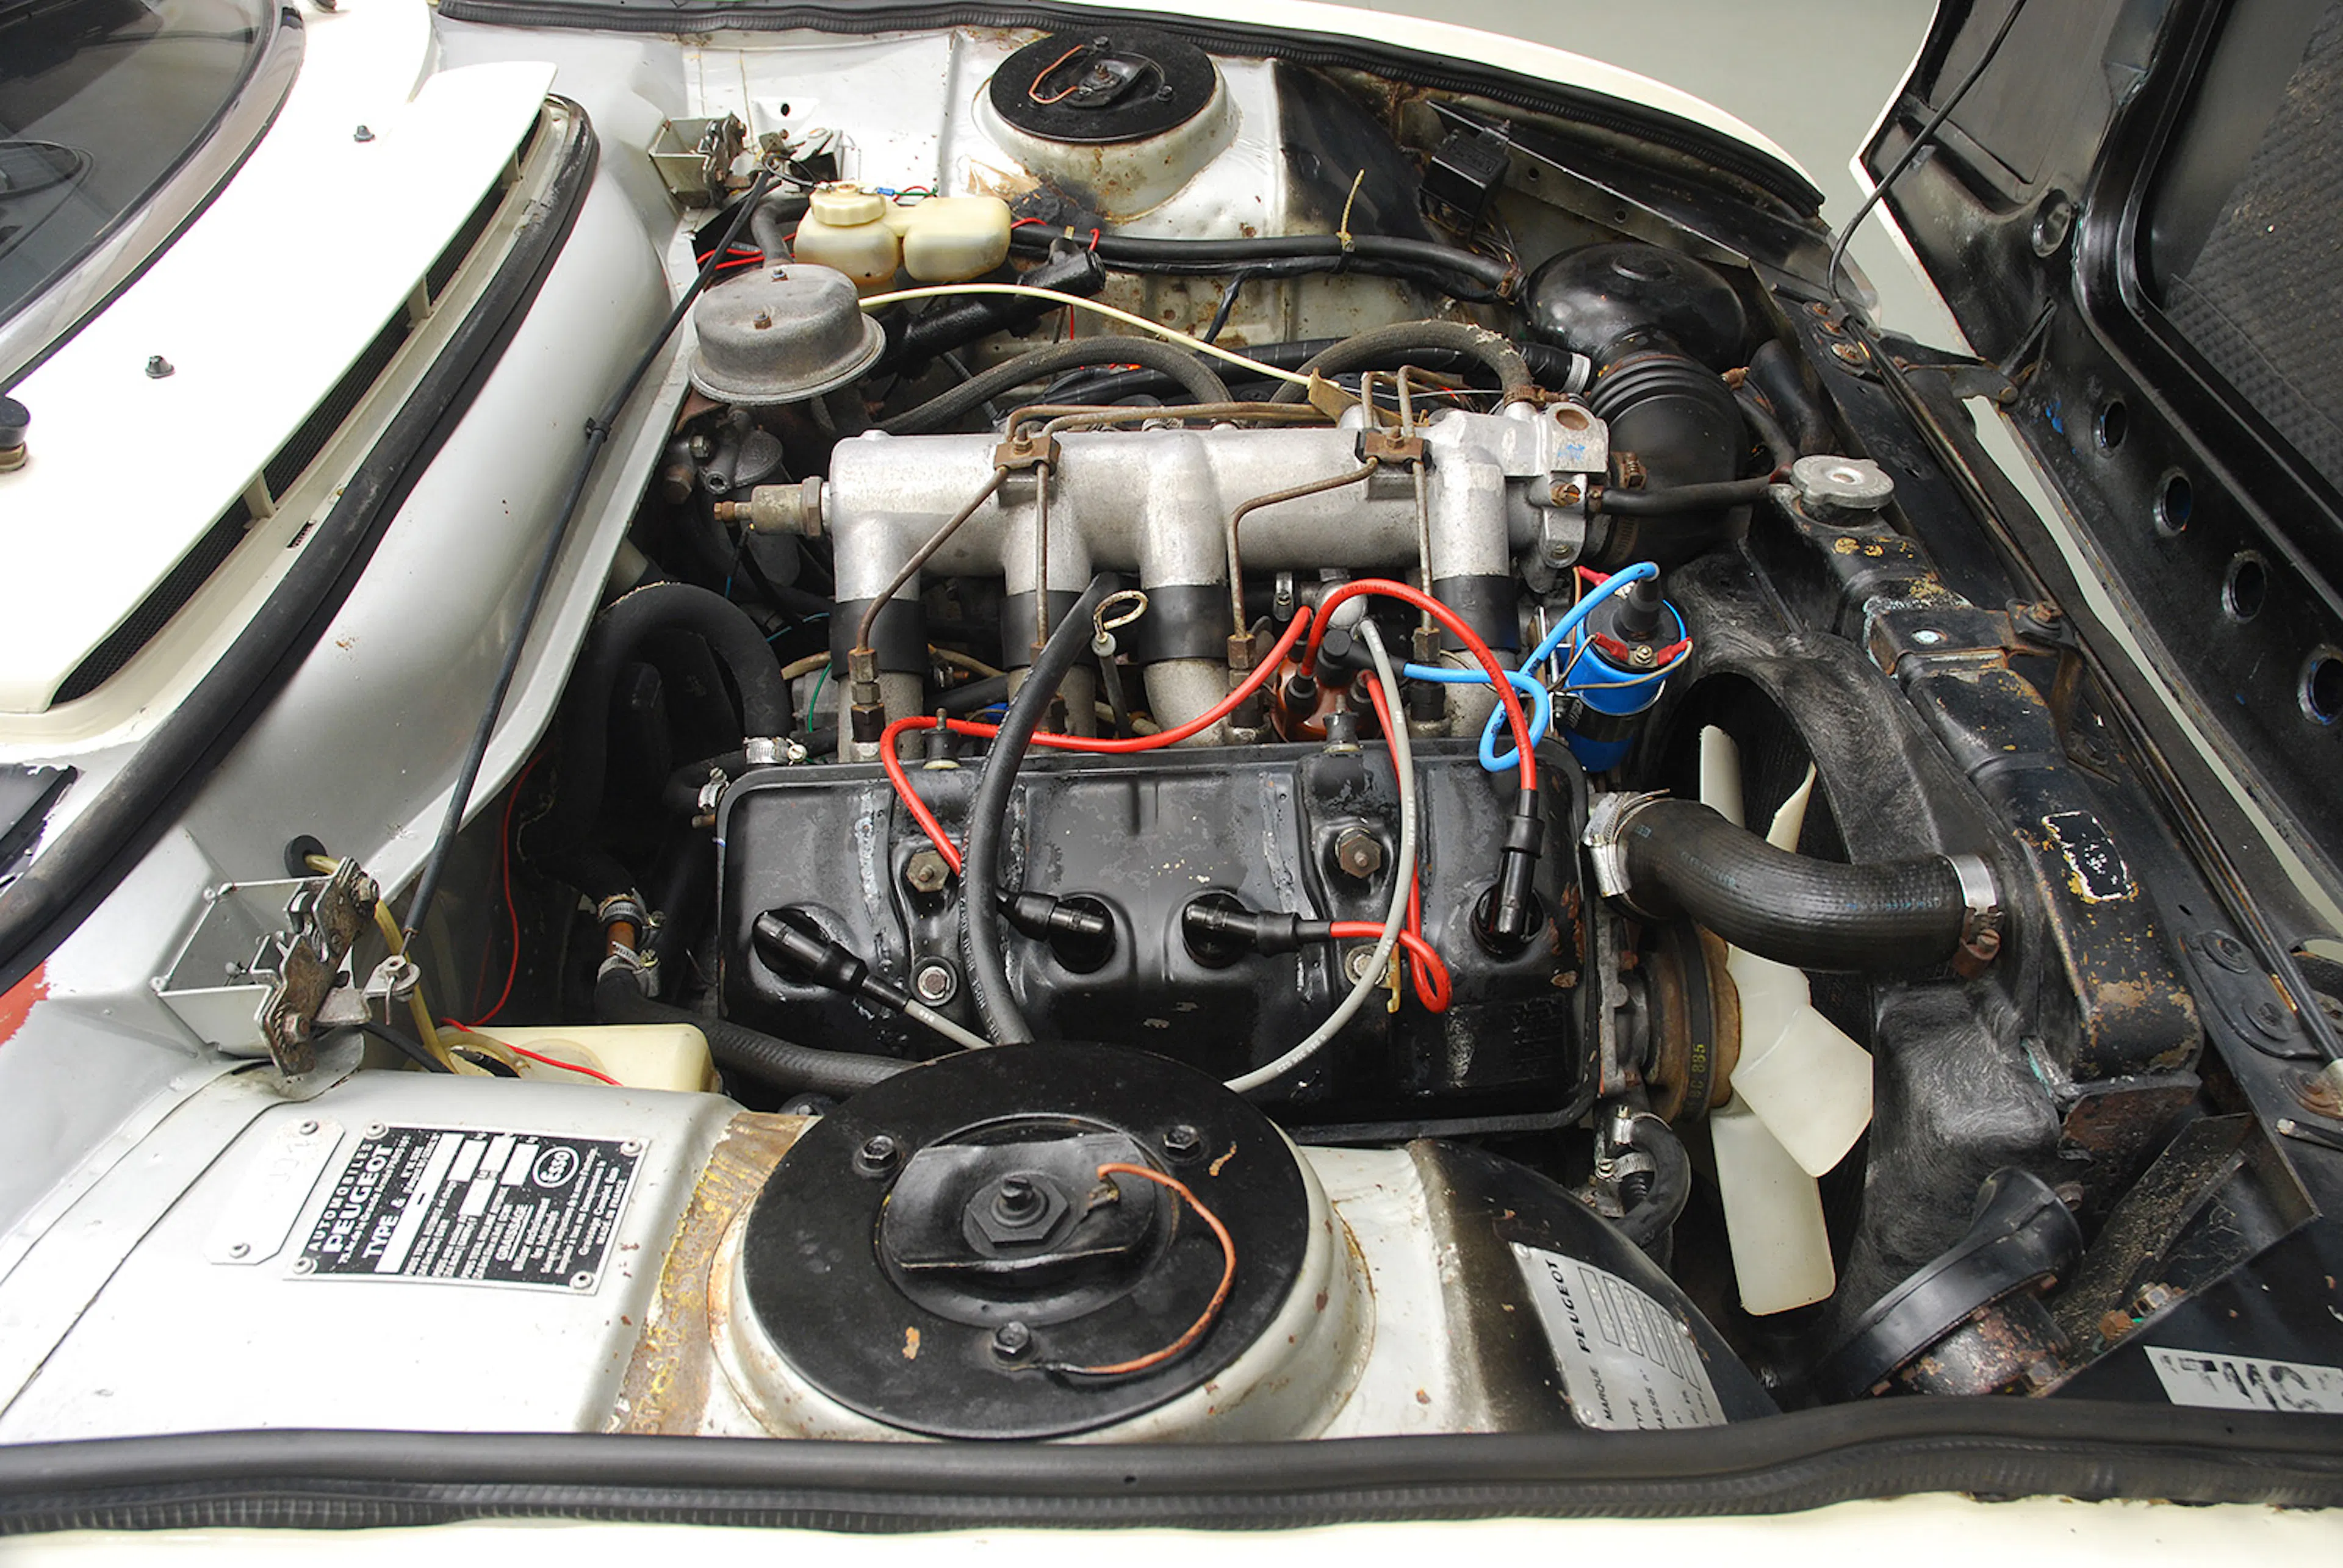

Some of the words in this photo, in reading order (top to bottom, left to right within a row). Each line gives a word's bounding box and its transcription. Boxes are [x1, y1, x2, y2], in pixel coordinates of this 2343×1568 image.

[971, 977, 987, 1010] HOSE
[1691, 1043, 1707, 1073] 885
[304, 1143, 376, 1251] AUTOMOBILES
[318, 1144, 397, 1253] PEUGEOT
[578, 1217, 602, 1255] Graissage
[592, 1185, 613, 1215] Complet
[609, 1179, 627, 1207] FRANCE
[359, 1214, 400, 1258] TYPE
[387, 1197, 408, 1208] &
[494, 1204, 528, 1260] GRAISSAGE
[1545, 1259, 1591, 1354] PEUGEOT
[1589, 1365, 1614, 1422] MARQUE
